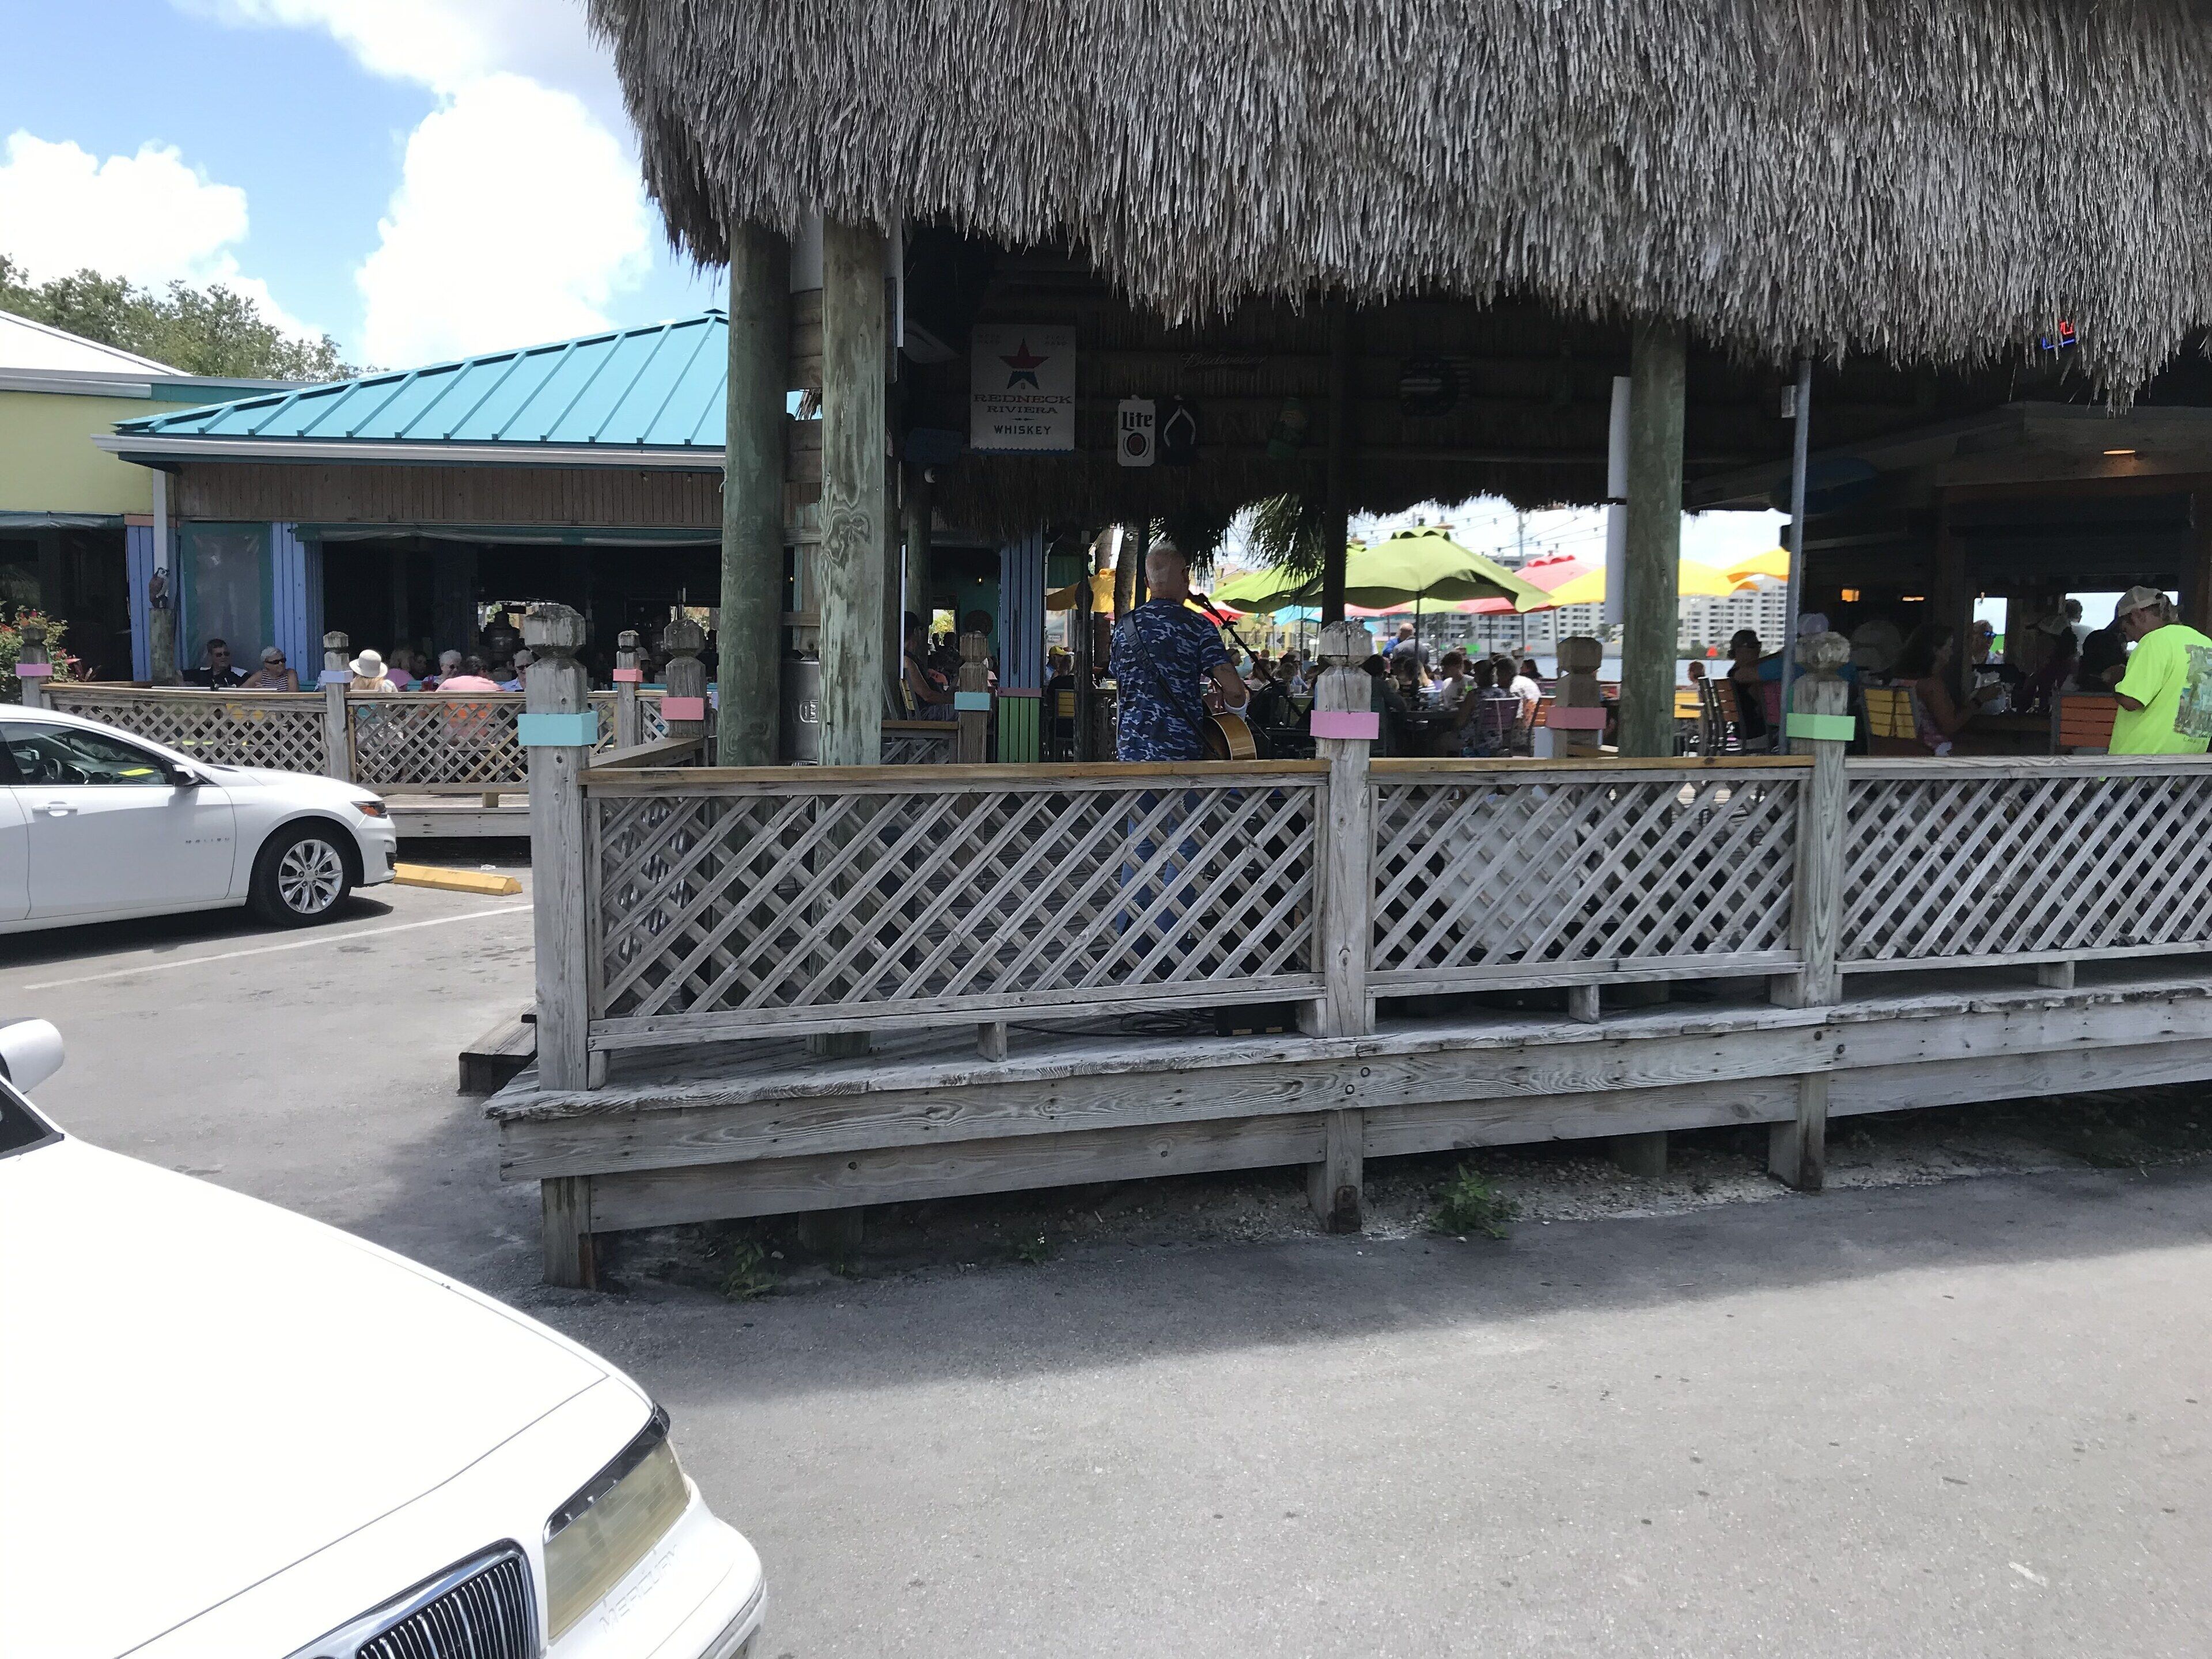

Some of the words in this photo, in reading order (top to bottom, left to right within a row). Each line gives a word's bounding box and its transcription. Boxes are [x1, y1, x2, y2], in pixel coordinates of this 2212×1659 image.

[974, 394, 1073, 404] REDNECK
[987, 406, 1058, 414] RIVIERA
[1121, 411, 1153, 431] Lite
[994, 425, 1051, 435] WHISKEY
[599, 1543, 679, 1634] MERCURY
